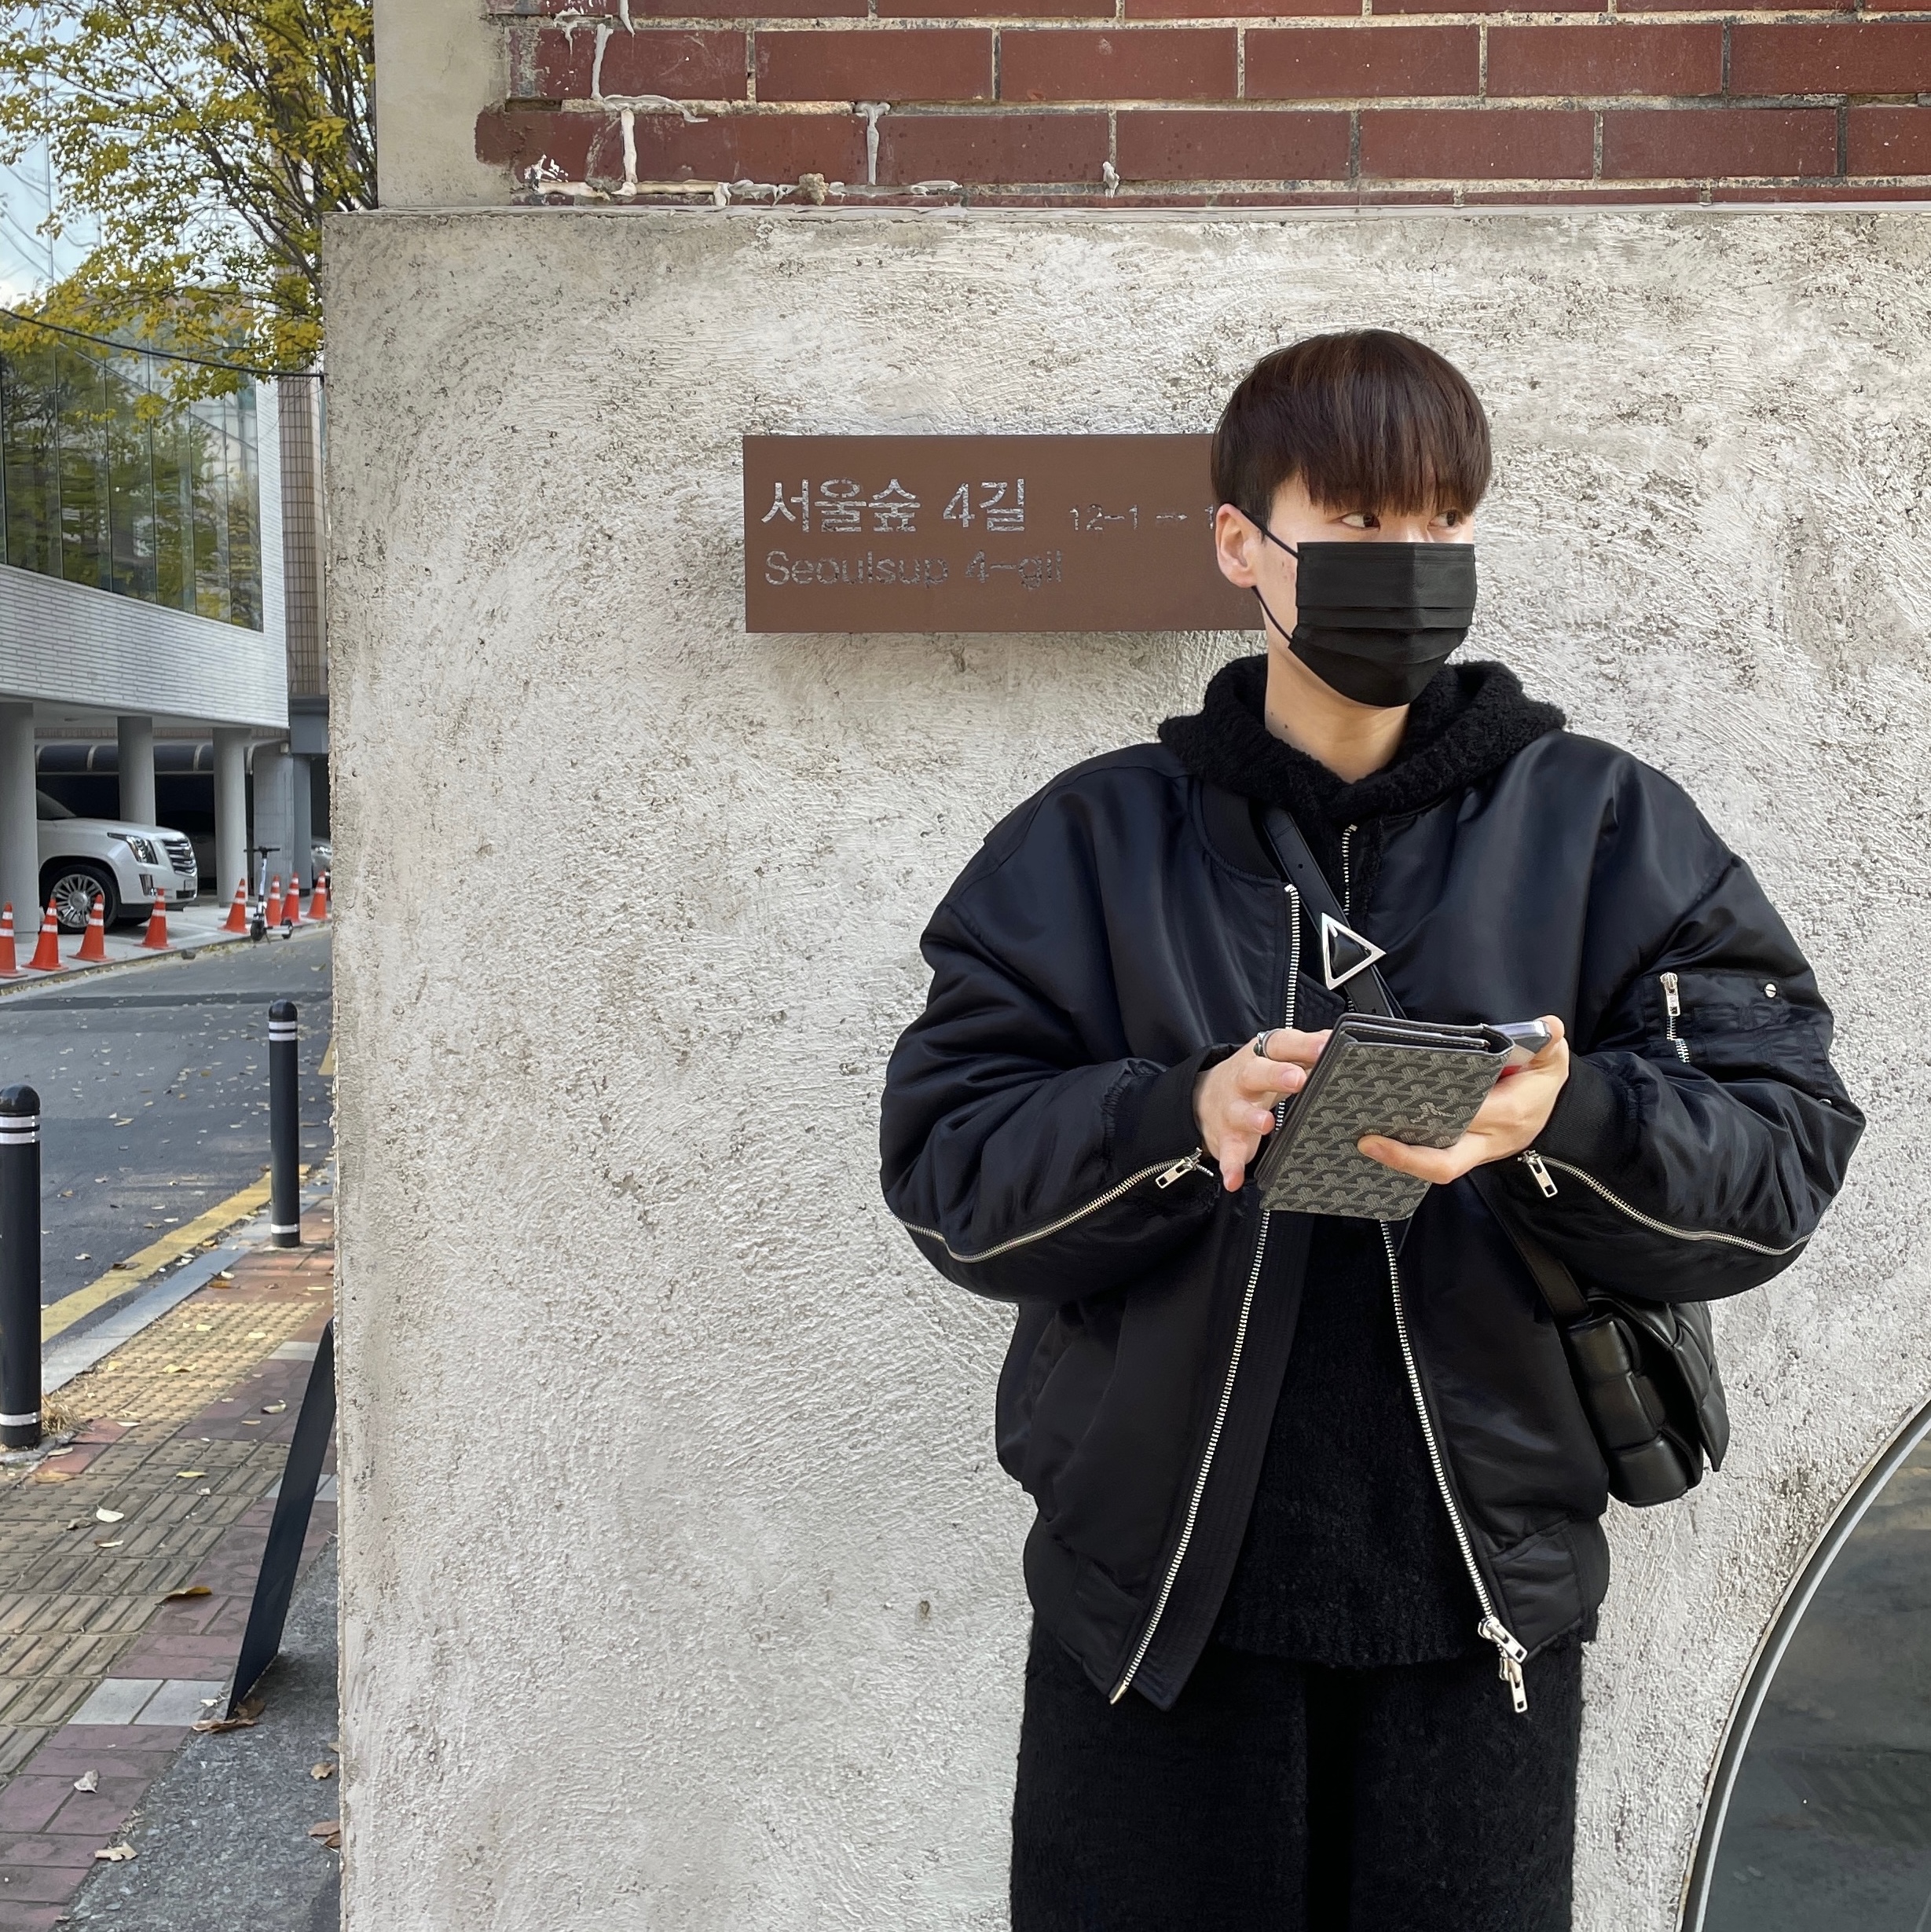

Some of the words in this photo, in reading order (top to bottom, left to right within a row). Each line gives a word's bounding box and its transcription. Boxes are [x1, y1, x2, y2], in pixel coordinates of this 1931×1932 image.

[760, 478, 922, 533] 서울숲
[942, 478, 1025, 533] 4길
[764, 550, 949, 589] Seoulsup
[964, 550, 1063, 592] 4-gil
